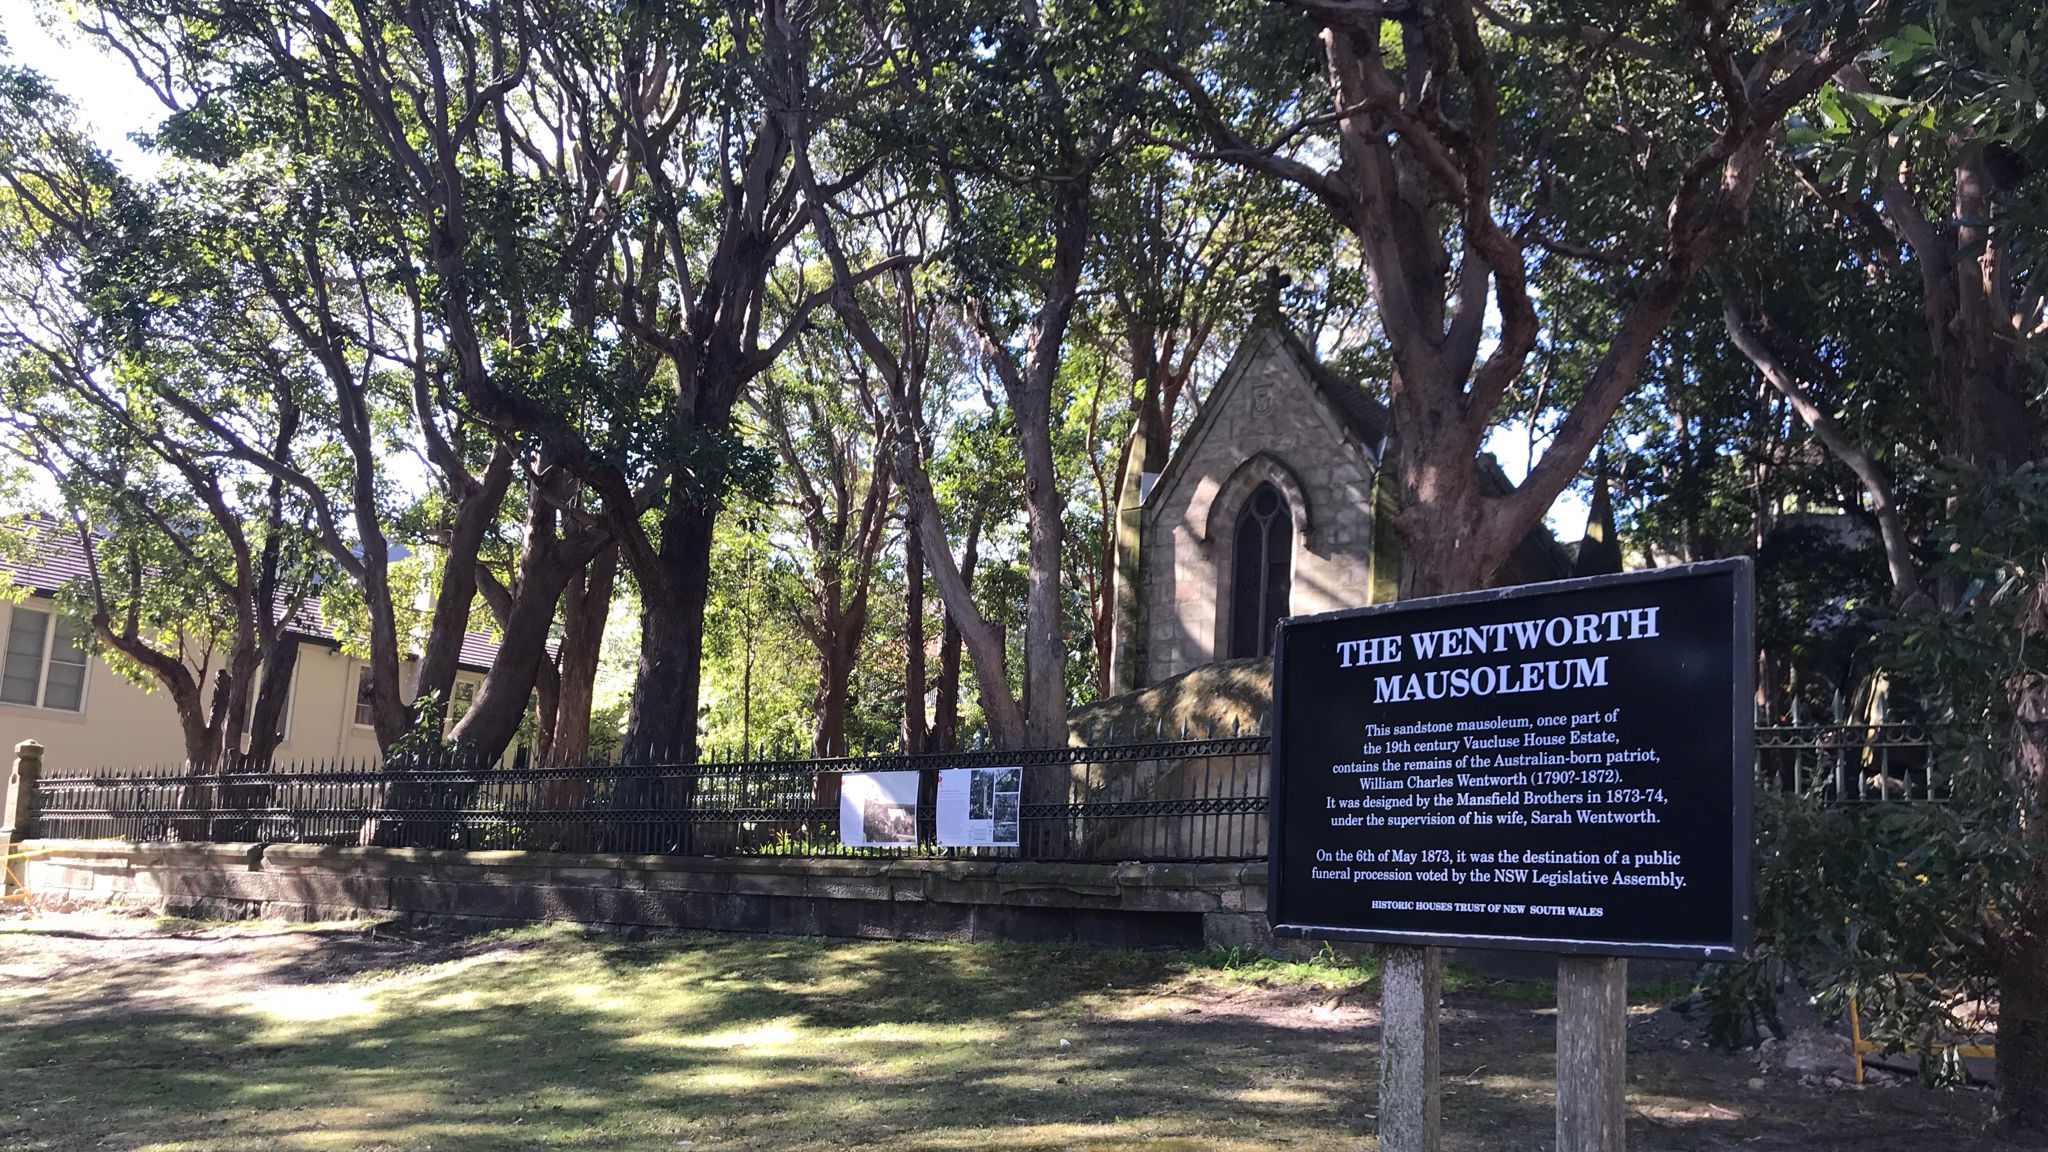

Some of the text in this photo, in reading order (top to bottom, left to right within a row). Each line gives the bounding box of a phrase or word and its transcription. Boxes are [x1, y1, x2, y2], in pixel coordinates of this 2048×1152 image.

[1337, 607, 1660, 668] THE WENTWORTH
[1373, 656, 1609, 704] MAUSOLEUM
[1365, 708, 1620, 737] This sandstone mausoleum, once part of
[1363, 730, 1619, 755] the 19th century Vaucluse House Estate,
[1333, 748, 1660, 773] contains the remains of the Australian-born patriot,
[1359, 769, 1623, 790] William Charles Wentworth (1790?-1872).
[1326, 788, 1668, 810] It was designed by the Mansfield Brothers in 1873-74,
[1331, 809, 1660, 828] under the supervision of his wife, Sarah Wentworth.
[1316, 849, 1681, 868] On the 6th of May 1873, it was the destination of a public
[1312, 866, 1687, 890] funeral procession voted by the NSW Legislative Assembly.
[1372, 900, 1603, 917] HISTORIC HOUSES TRUST OF NEW SOUTH WALES
